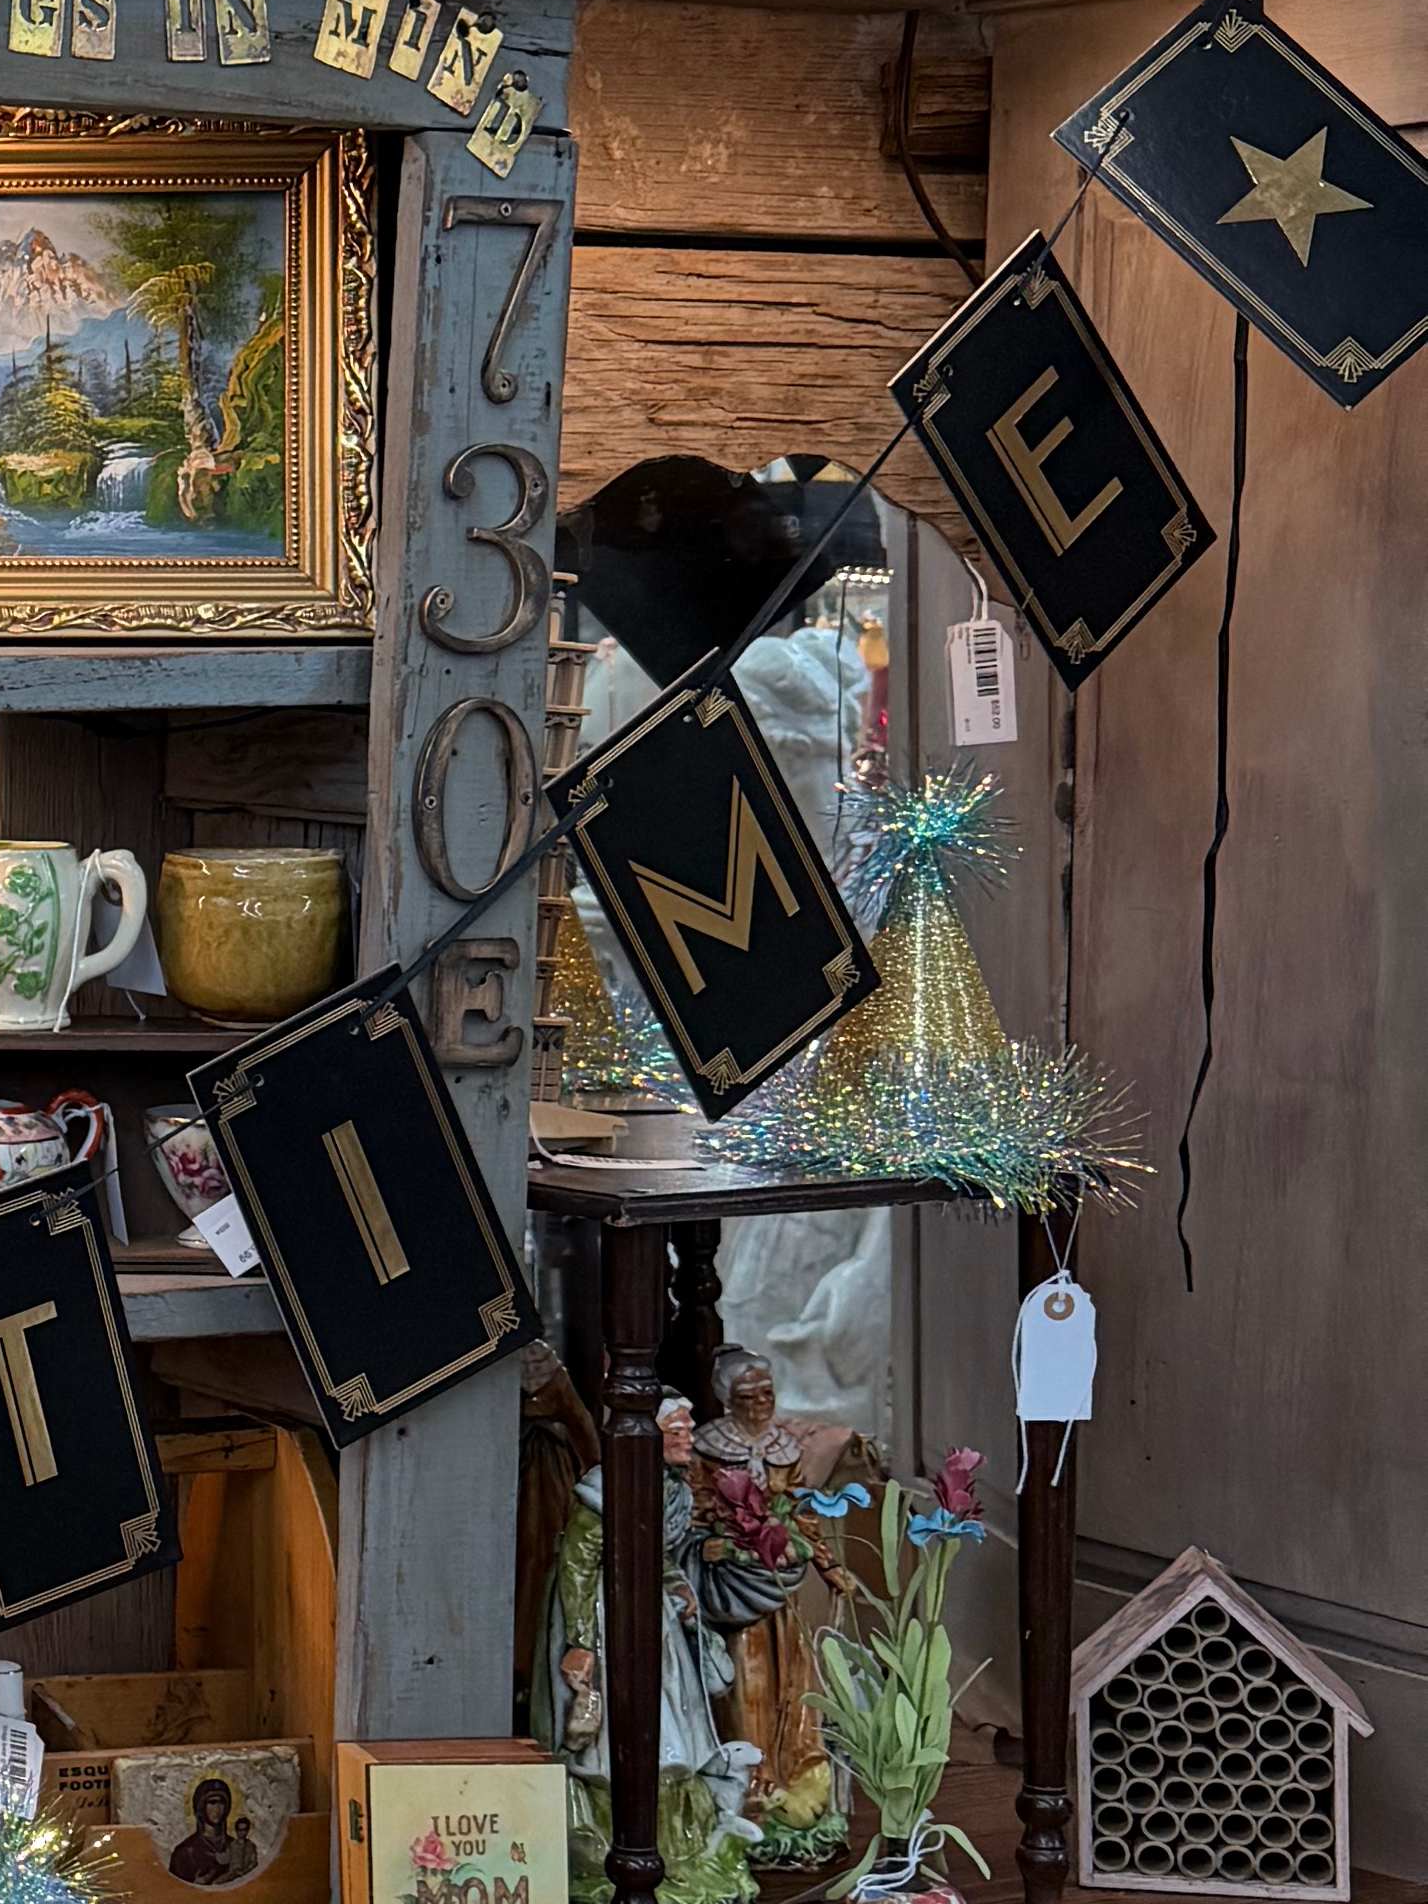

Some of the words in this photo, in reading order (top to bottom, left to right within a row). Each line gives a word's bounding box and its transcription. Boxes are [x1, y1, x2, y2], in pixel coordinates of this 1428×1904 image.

[410, 193, 567, 1070] 730E
[58, 1765, 109, 1778] ESQU
[431, 1815, 441, 1837] I
[444, 1813, 500, 1837] LOVE
[450, 1839, 487, 1857] YOU
